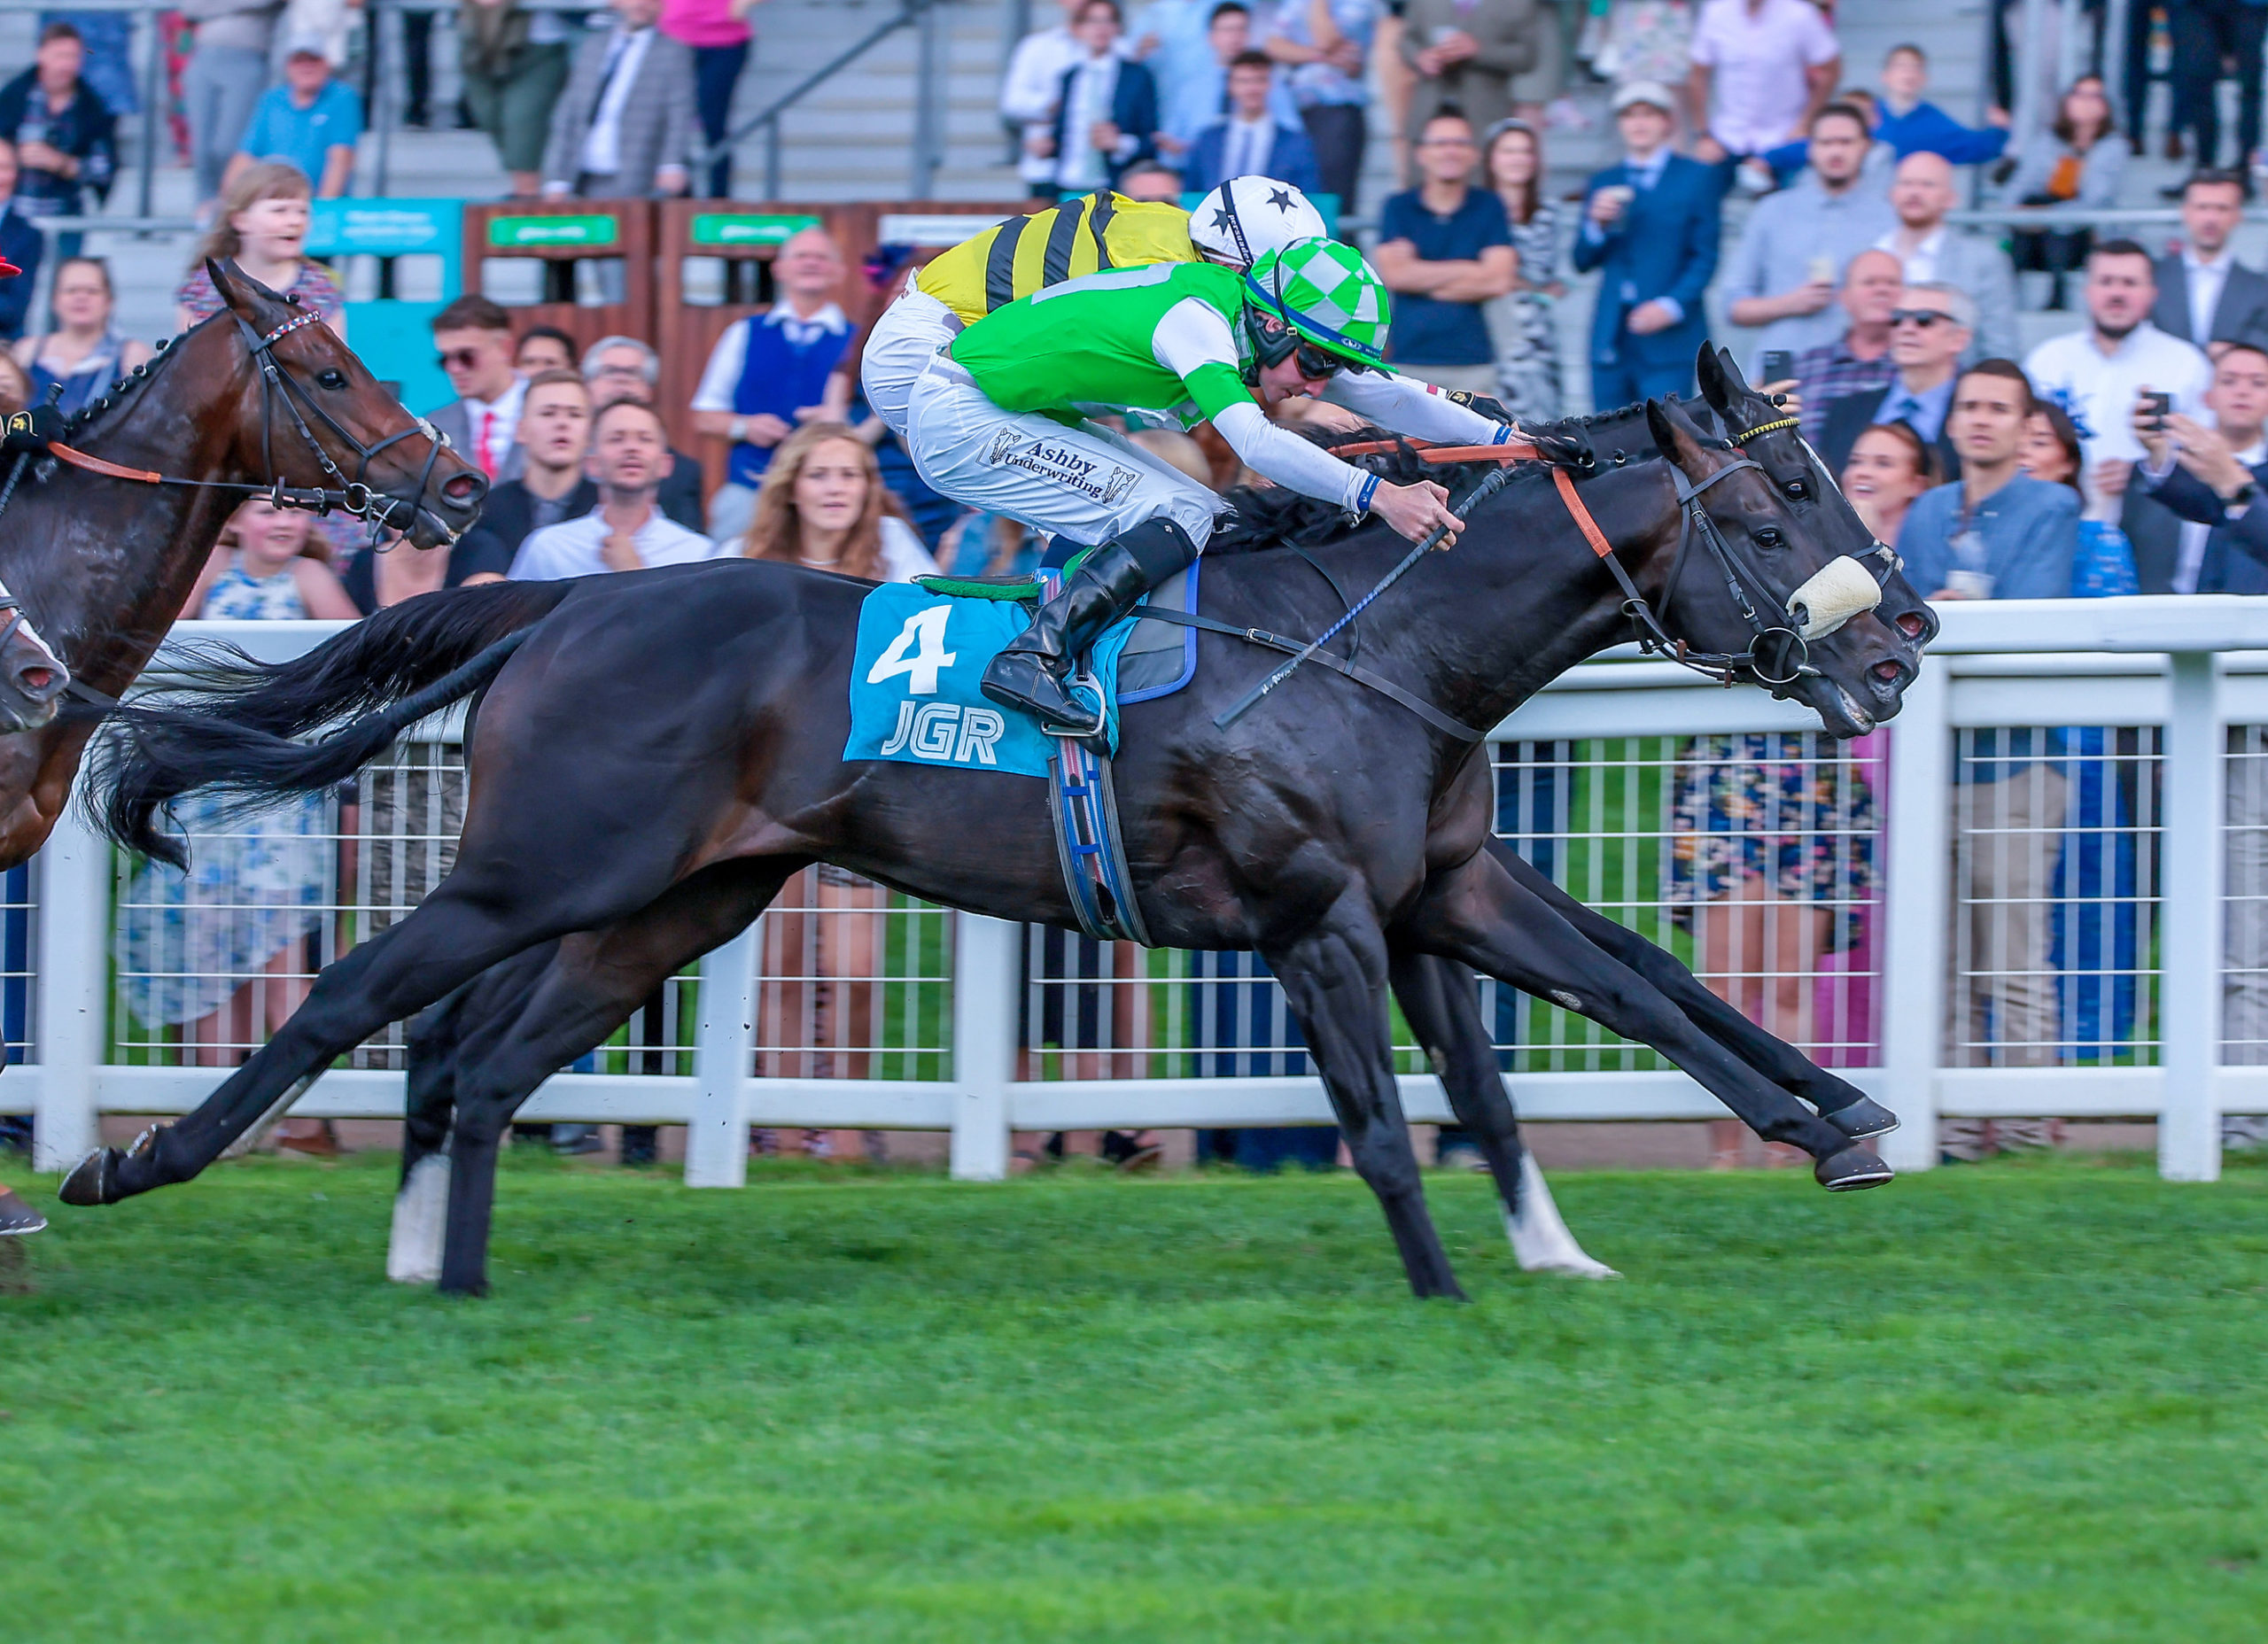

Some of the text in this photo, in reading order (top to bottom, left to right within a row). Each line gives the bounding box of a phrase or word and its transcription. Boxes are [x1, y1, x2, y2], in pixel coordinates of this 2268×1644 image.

[1228, 214, 1252, 266] persuader
[1005, 453, 1103, 499] Underwriting
[1025, 442, 1098, 476] Ashby
[866, 604, 957, 694] 4
[880, 701, 1005, 764] JGR
